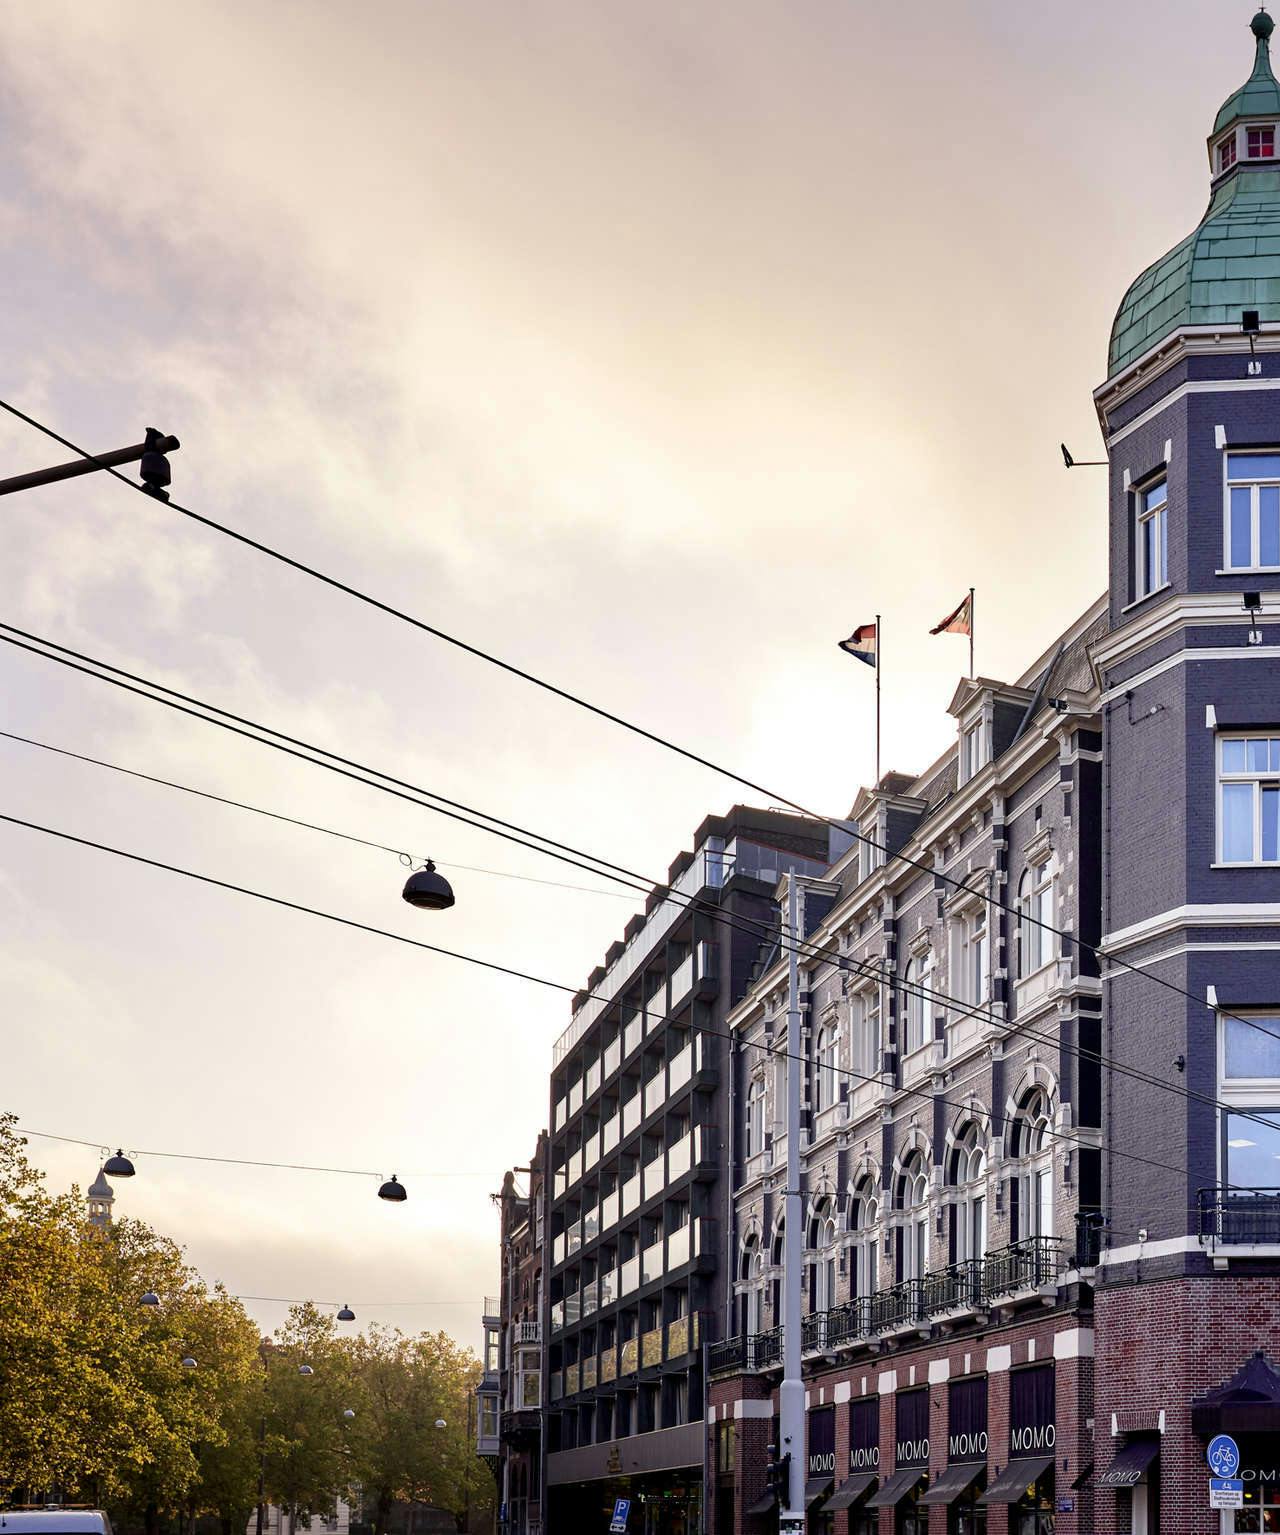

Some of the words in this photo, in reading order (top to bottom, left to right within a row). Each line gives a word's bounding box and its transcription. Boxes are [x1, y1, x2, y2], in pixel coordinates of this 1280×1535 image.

[949, 1431, 988, 1456] MOMO
[1011, 1424, 1055, 1450] MOMO
[850, 1446, 880, 1467] MOMO
[897, 1439, 930, 1461] MOMO
[810, 1453, 835, 1472] MOMO
[1098, 1471, 1141, 1483] MOMO
